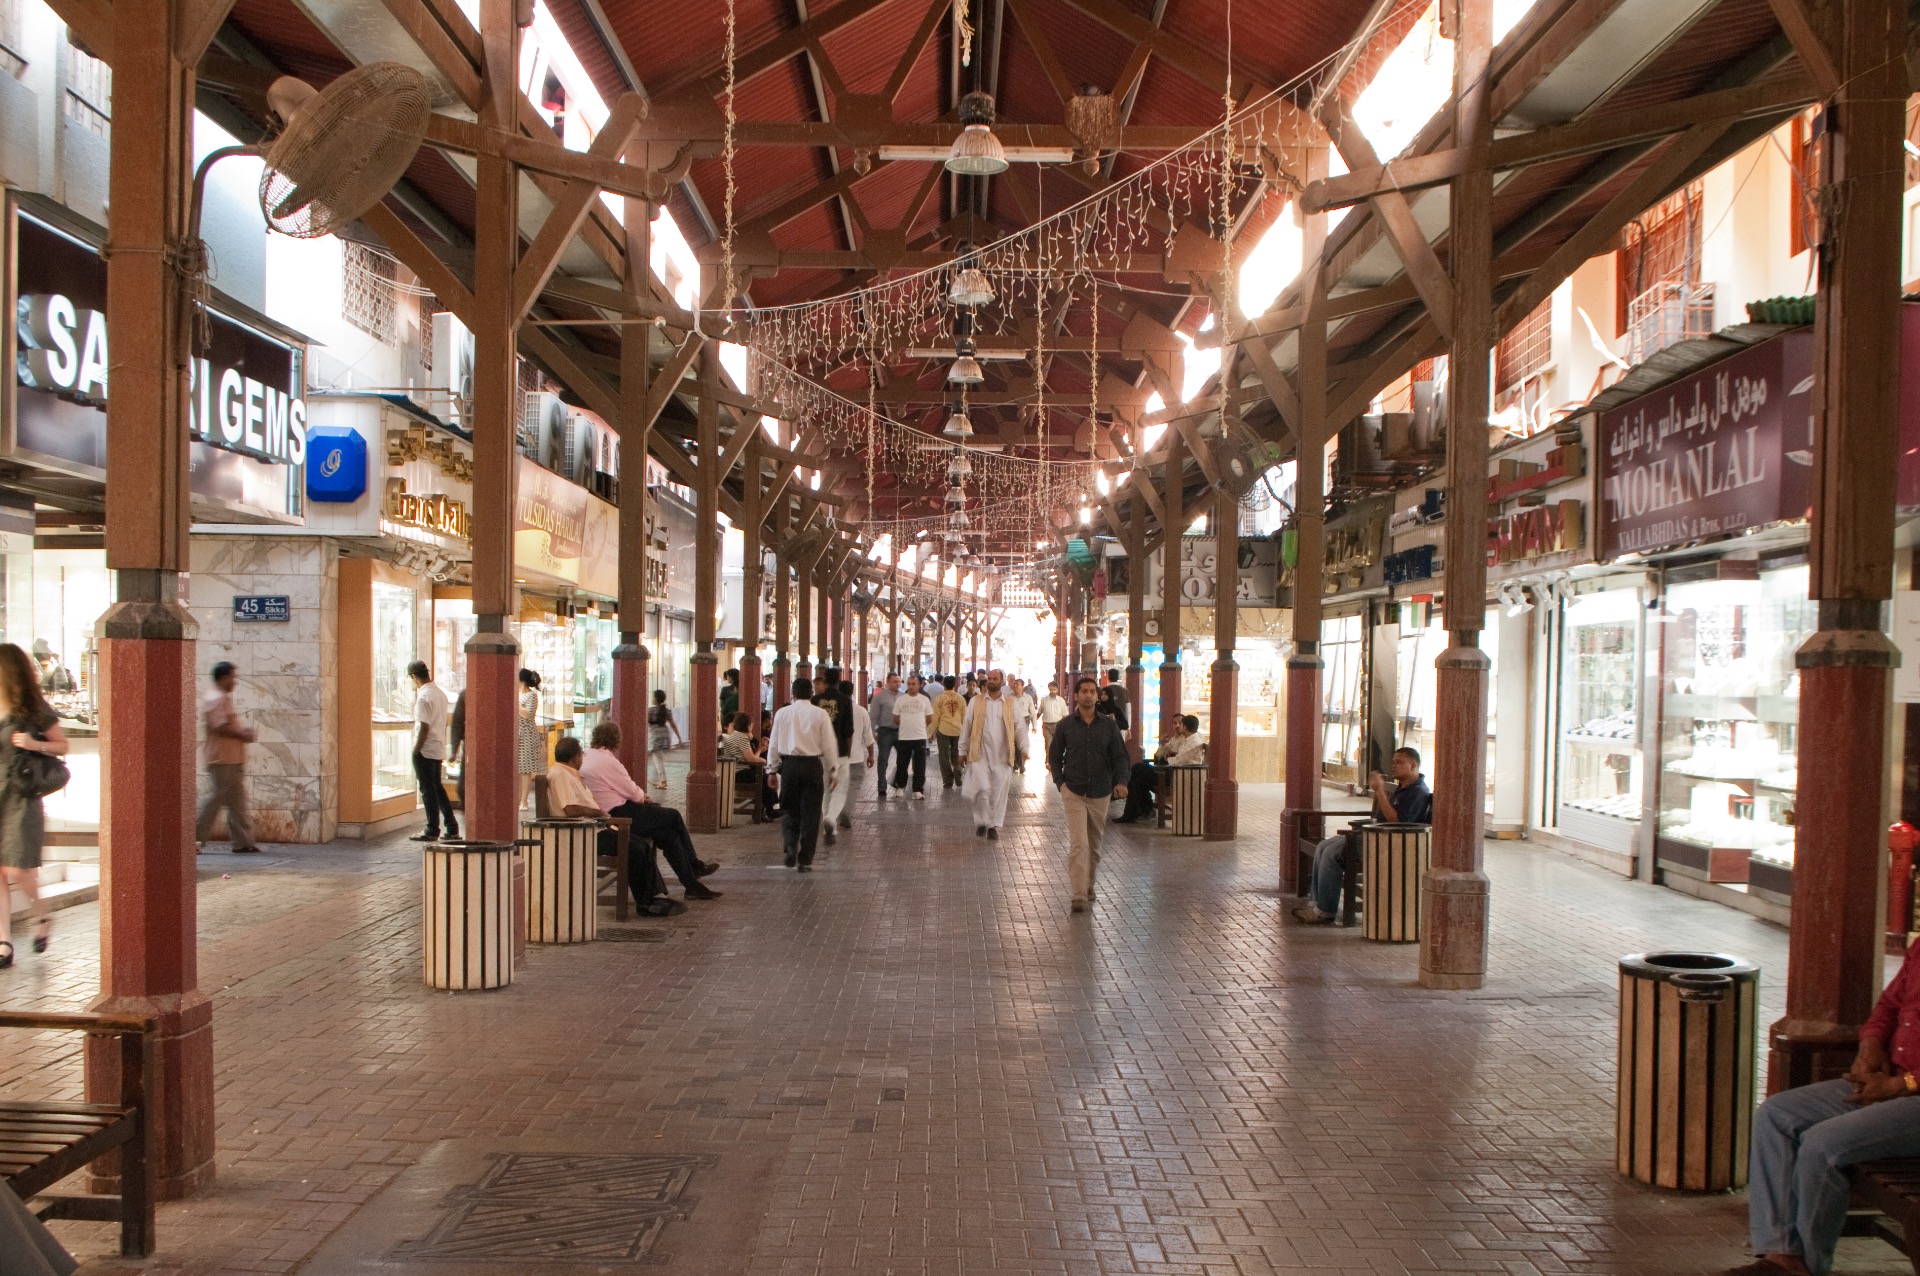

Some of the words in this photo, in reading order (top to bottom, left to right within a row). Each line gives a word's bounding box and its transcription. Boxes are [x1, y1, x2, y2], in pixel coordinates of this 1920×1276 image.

[219, 368, 306, 465] GEMS
[1611, 426, 1766, 523] MOHANLAL
[519, 495, 555, 533] TULSIDAS
[1618, 516, 1688, 551] VALLABHDAS
[241, 599, 258, 612] 45
